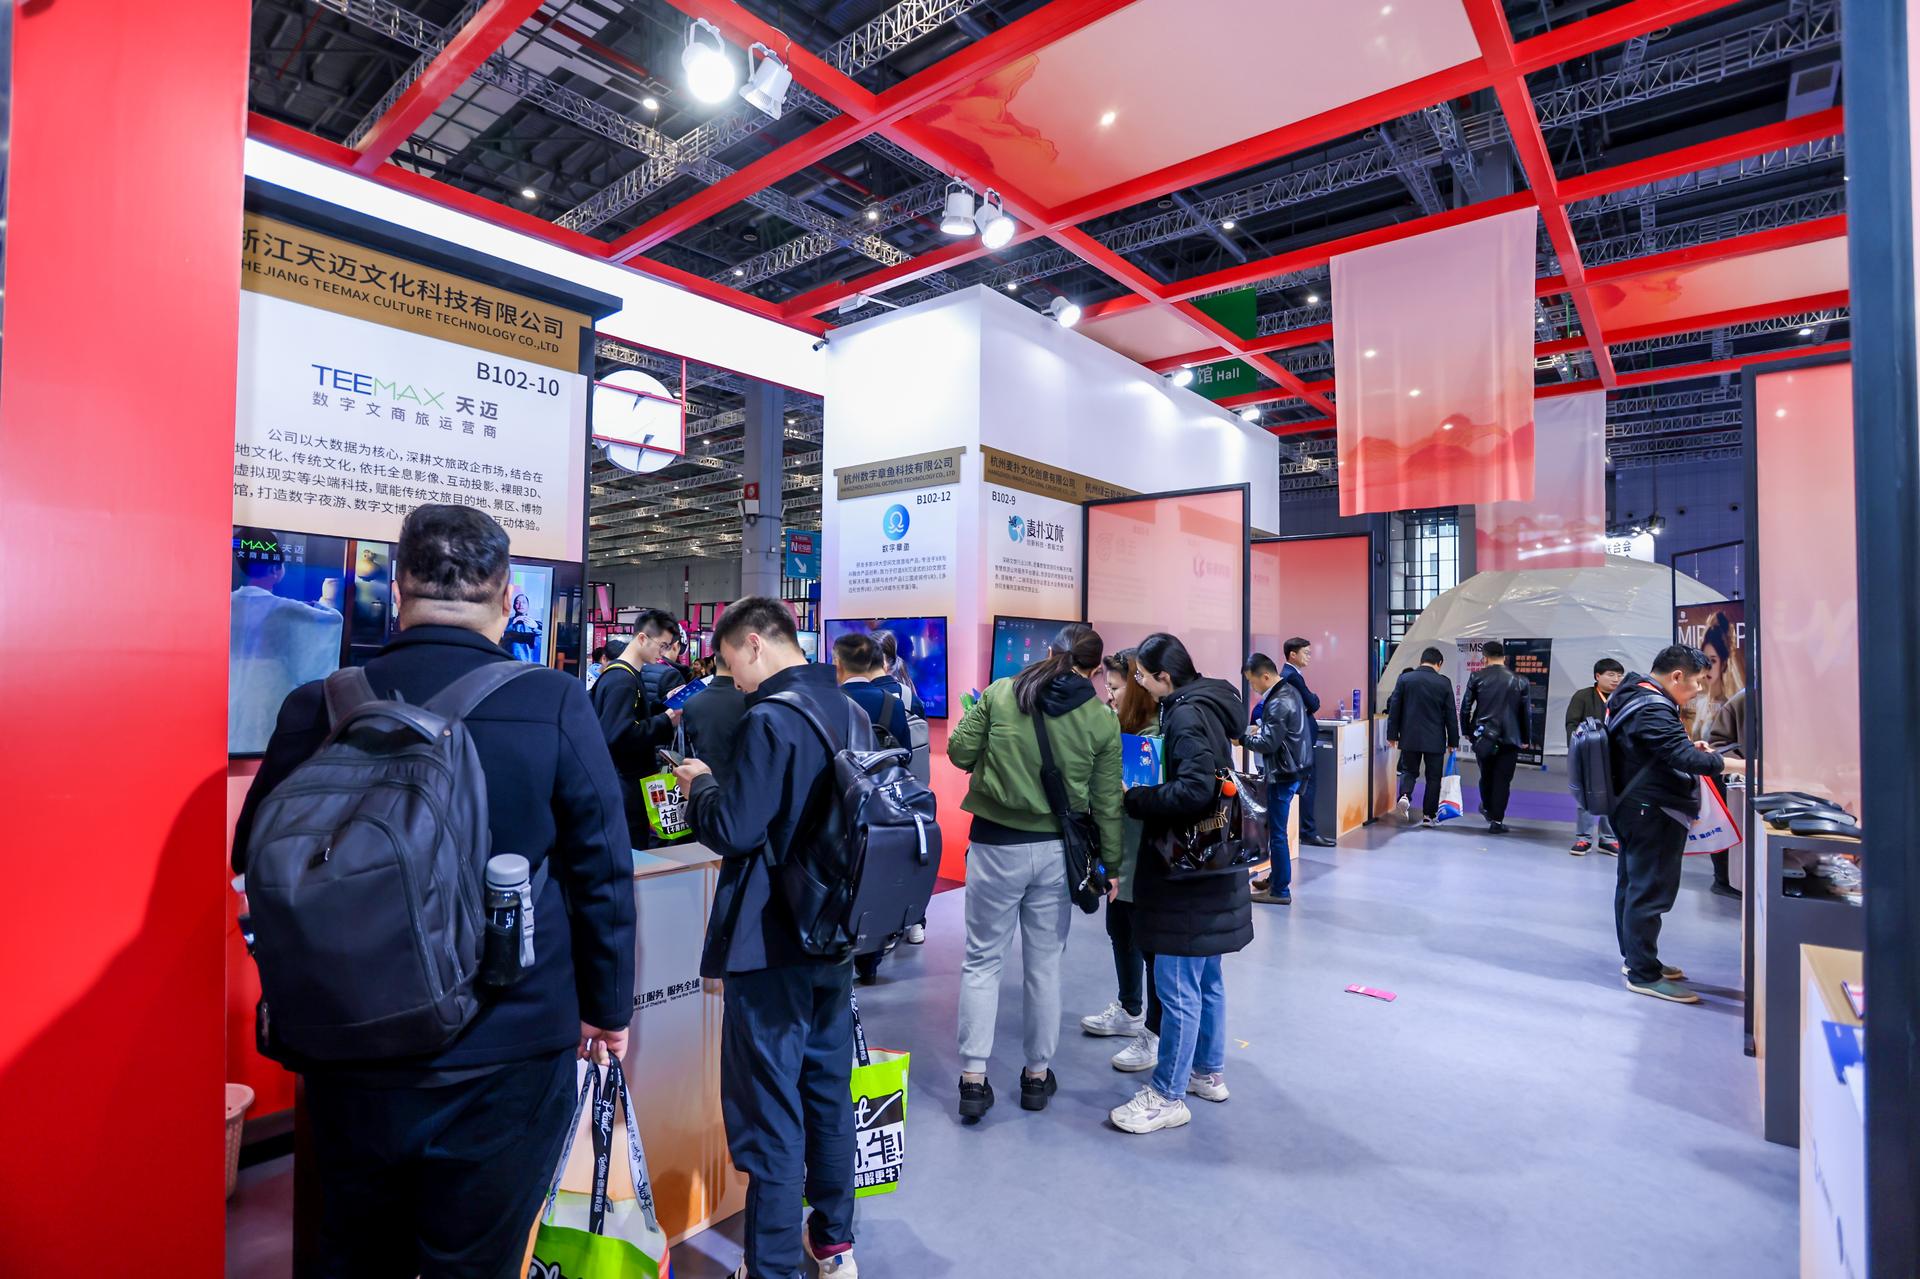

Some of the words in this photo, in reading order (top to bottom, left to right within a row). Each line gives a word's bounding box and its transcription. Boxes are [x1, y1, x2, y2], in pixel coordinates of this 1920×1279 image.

[313, 278, 370, 303] TEEMAX
[373, 295, 432, 320] CULTURE
[436, 312, 516, 342] TECHNOLOGY
[477, 361, 560, 396] B102-10
[1197, 366, 1213, 384] 馆
[1217, 367, 1240, 381] Hall
[311, 364, 445, 410] TEEMAX
[455, 395, 499, 421] 天迈
[312, 391, 497, 439] 数字文商旅运营商
[844, 457, 953, 485] 杭州数字章鱼科技有限公司
[916, 491, 951, 505] B102-12
[992, 491, 1016, 505] B102-9
[282, 544, 304, 554] 天迈
[667, 978, 700, 996] 服务全球
